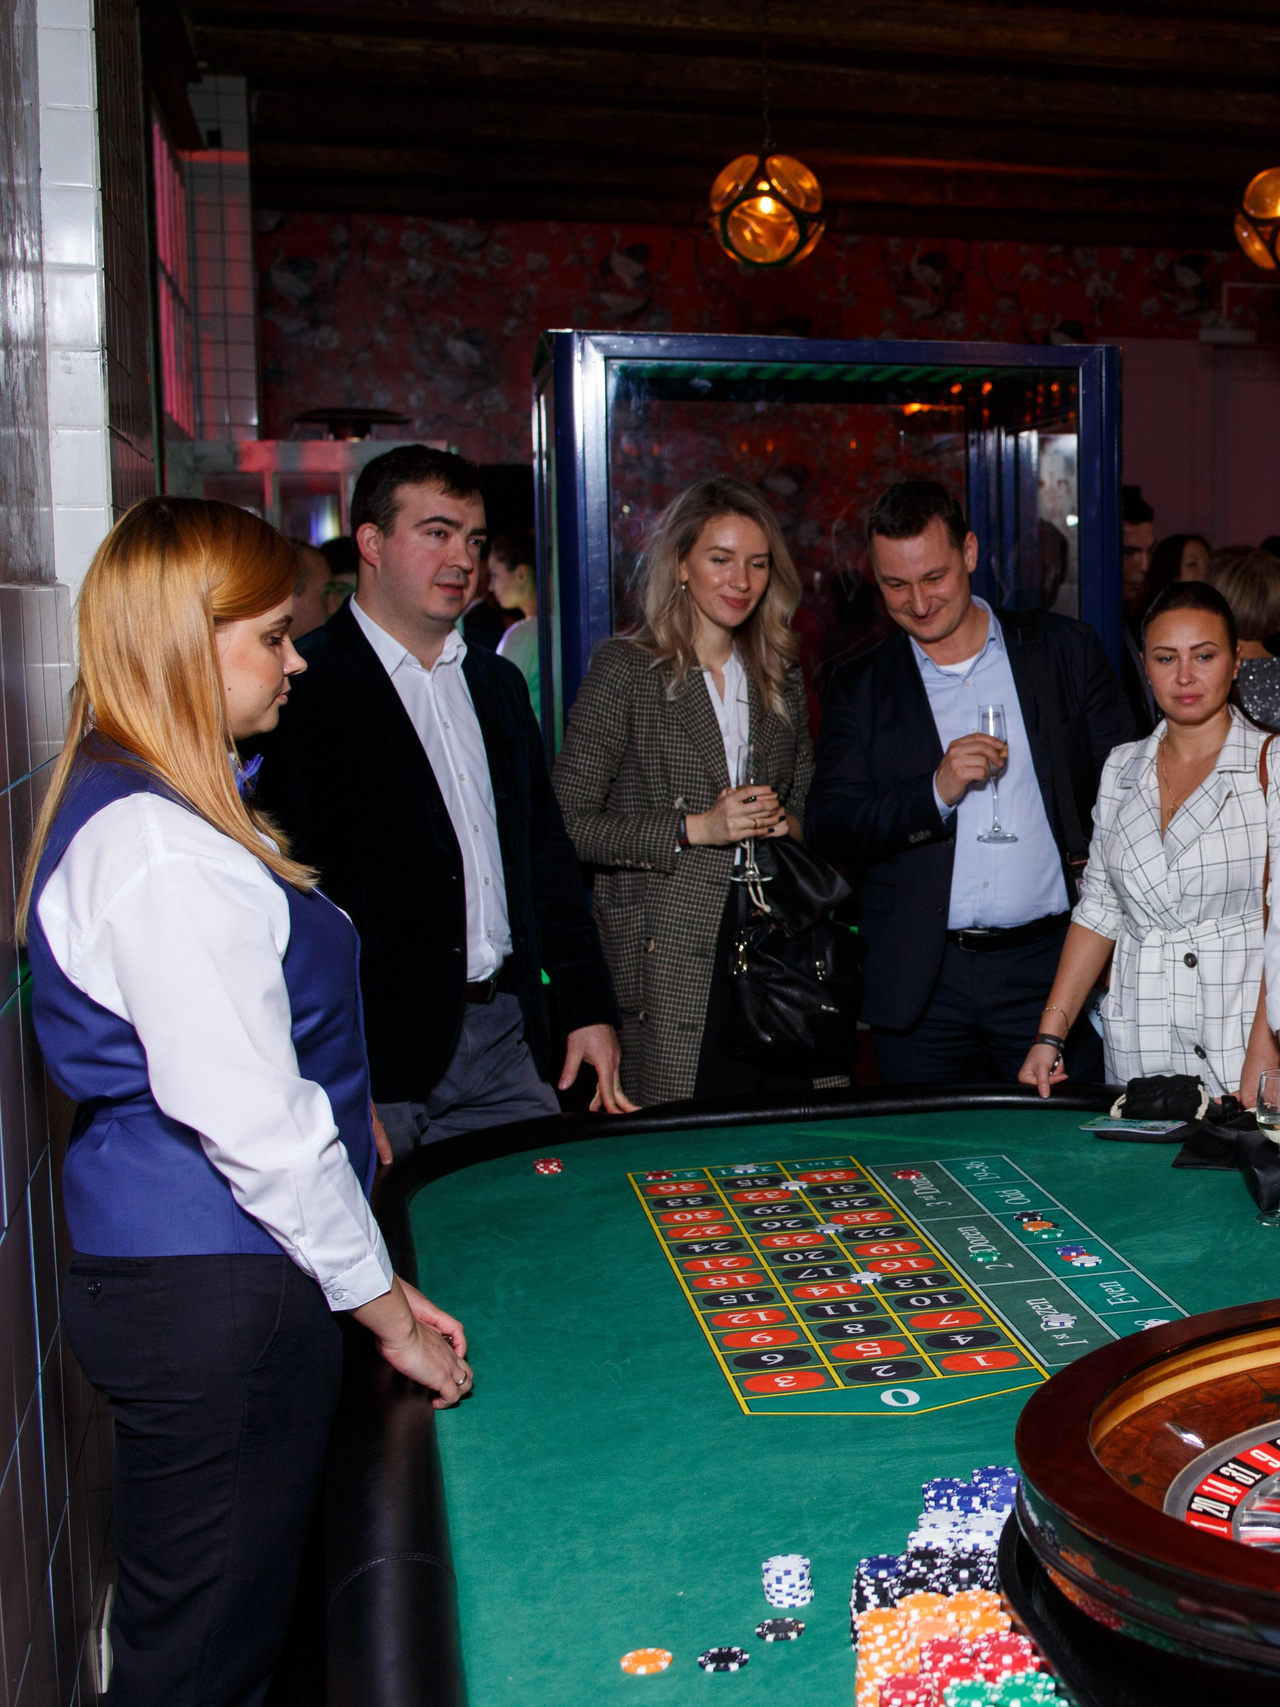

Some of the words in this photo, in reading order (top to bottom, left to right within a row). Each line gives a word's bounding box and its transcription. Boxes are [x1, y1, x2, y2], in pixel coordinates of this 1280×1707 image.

[811, 1172, 846, 1180] 34
[659, 1183, 695, 1192] 36
[737, 1178, 769, 1187] 35
[744, 1191, 780, 1200] 32
[821, 1185, 856, 1194] 31
[666, 1197, 702, 1207] 33
[994, 1188, 1032, 1205] Odd
[831, 1198, 869, 1208] 28
[674, 1211, 712, 1221] 30
[753, 1205, 791, 1215] 29
[843, 1213, 879, 1223] 25
[761, 1219, 802, 1230] 26
[682, 1226, 720, 1237] 27
[854, 1227, 895, 1238] 22
[772, 1235, 812, 1246] 23
[957, 1225, 998, 1254] Dozen
[688, 1241, 730, 1253] 24
[869, 1243, 906, 1254] 19
[783, 1250, 825, 1262] 20
[698, 1257, 739, 1269] 21
[880, 1259, 919, 1270] 16
[797, 1267, 836, 1279] 17
[708, 1275, 747, 1286] 18
[894, 1276, 934, 1288] 13
[807, 1284, 847, 1297] 14
[1098, 1280, 1139, 1306] Even
[718, 1293, 757, 1305] 15
[909, 1294, 952, 1306] 10
[821, 1302, 861, 1315] 11
[1025, 1297, 1075, 1332] Dzen
[727, 1311, 771, 1324] 12
[939, 1314, 960, 1325] 7
[842, 1323, 866, 1334] 8
[750, 1332, 773, 1344] 9
[949, 1334, 974, 1346] 4
[855, 1342, 882, 1357] 5
[760, 1353, 784, 1366] 6
[969, 1354, 993, 1367] 1
[871, 1364, 896, 1377] 2
[774, 1375, 797, 1388] 3
[880, 1388, 921, 1407] 0
[1219, 1462, 1262, 1486] 31
[1202, 1479, 1242, 1501] 14
[1191, 1496, 1231, 1519] 20
